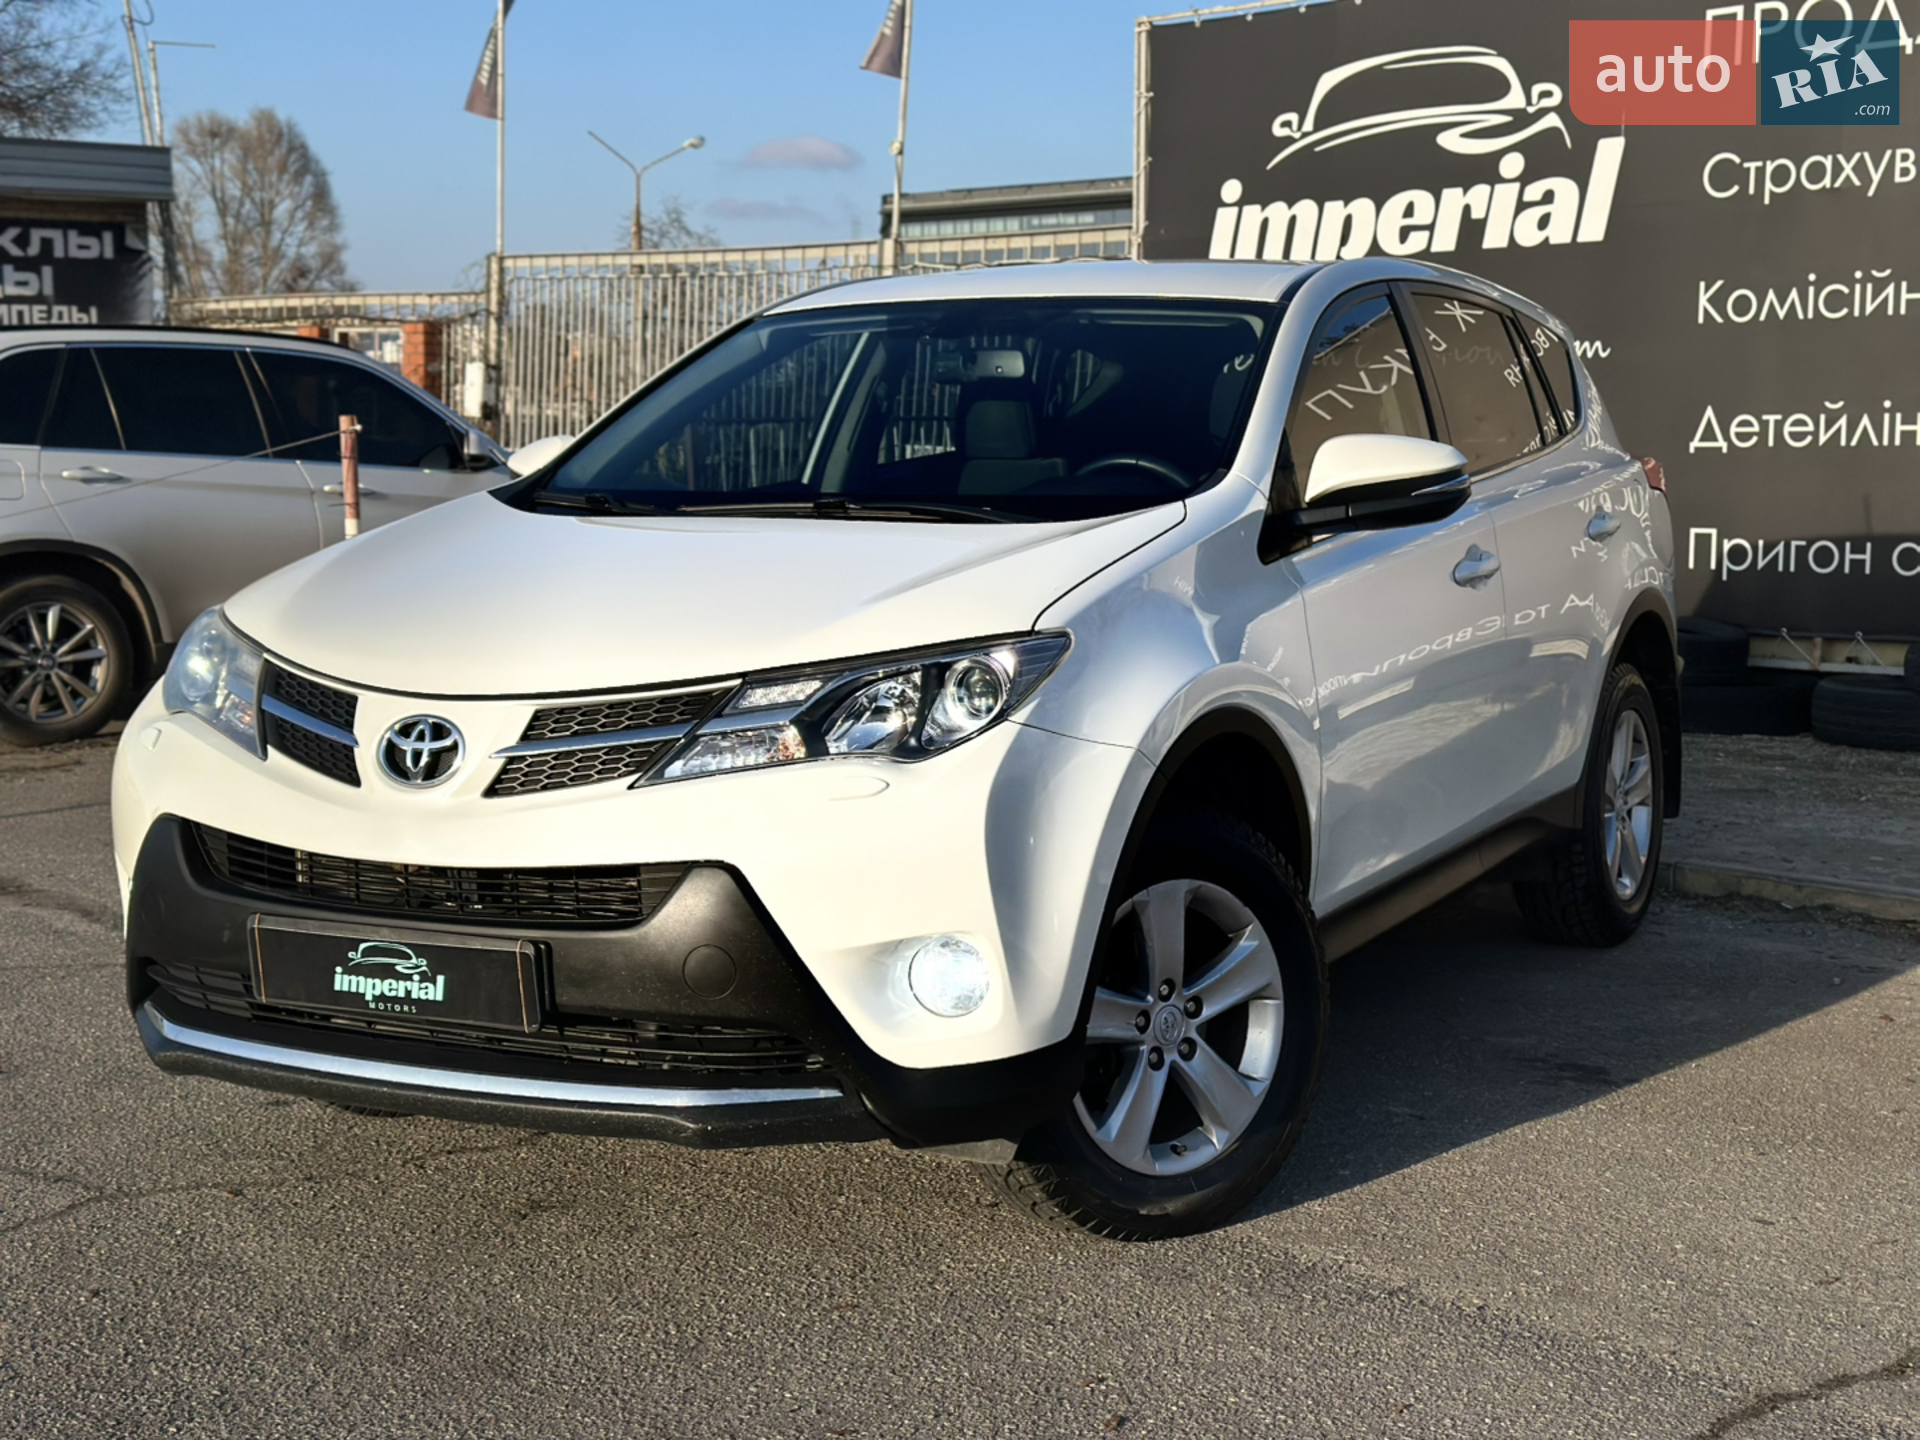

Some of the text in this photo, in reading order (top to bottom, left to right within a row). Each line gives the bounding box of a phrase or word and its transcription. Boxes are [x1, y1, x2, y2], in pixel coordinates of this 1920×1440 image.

[1209, 136, 1626, 260] imperial
[1702, 147, 1917, 205] Страхув
[1688, 527, 1872, 581] Пригон
[333, 966, 445, 1001] imperial
[368, 1001, 417, 1013] MOTORS
